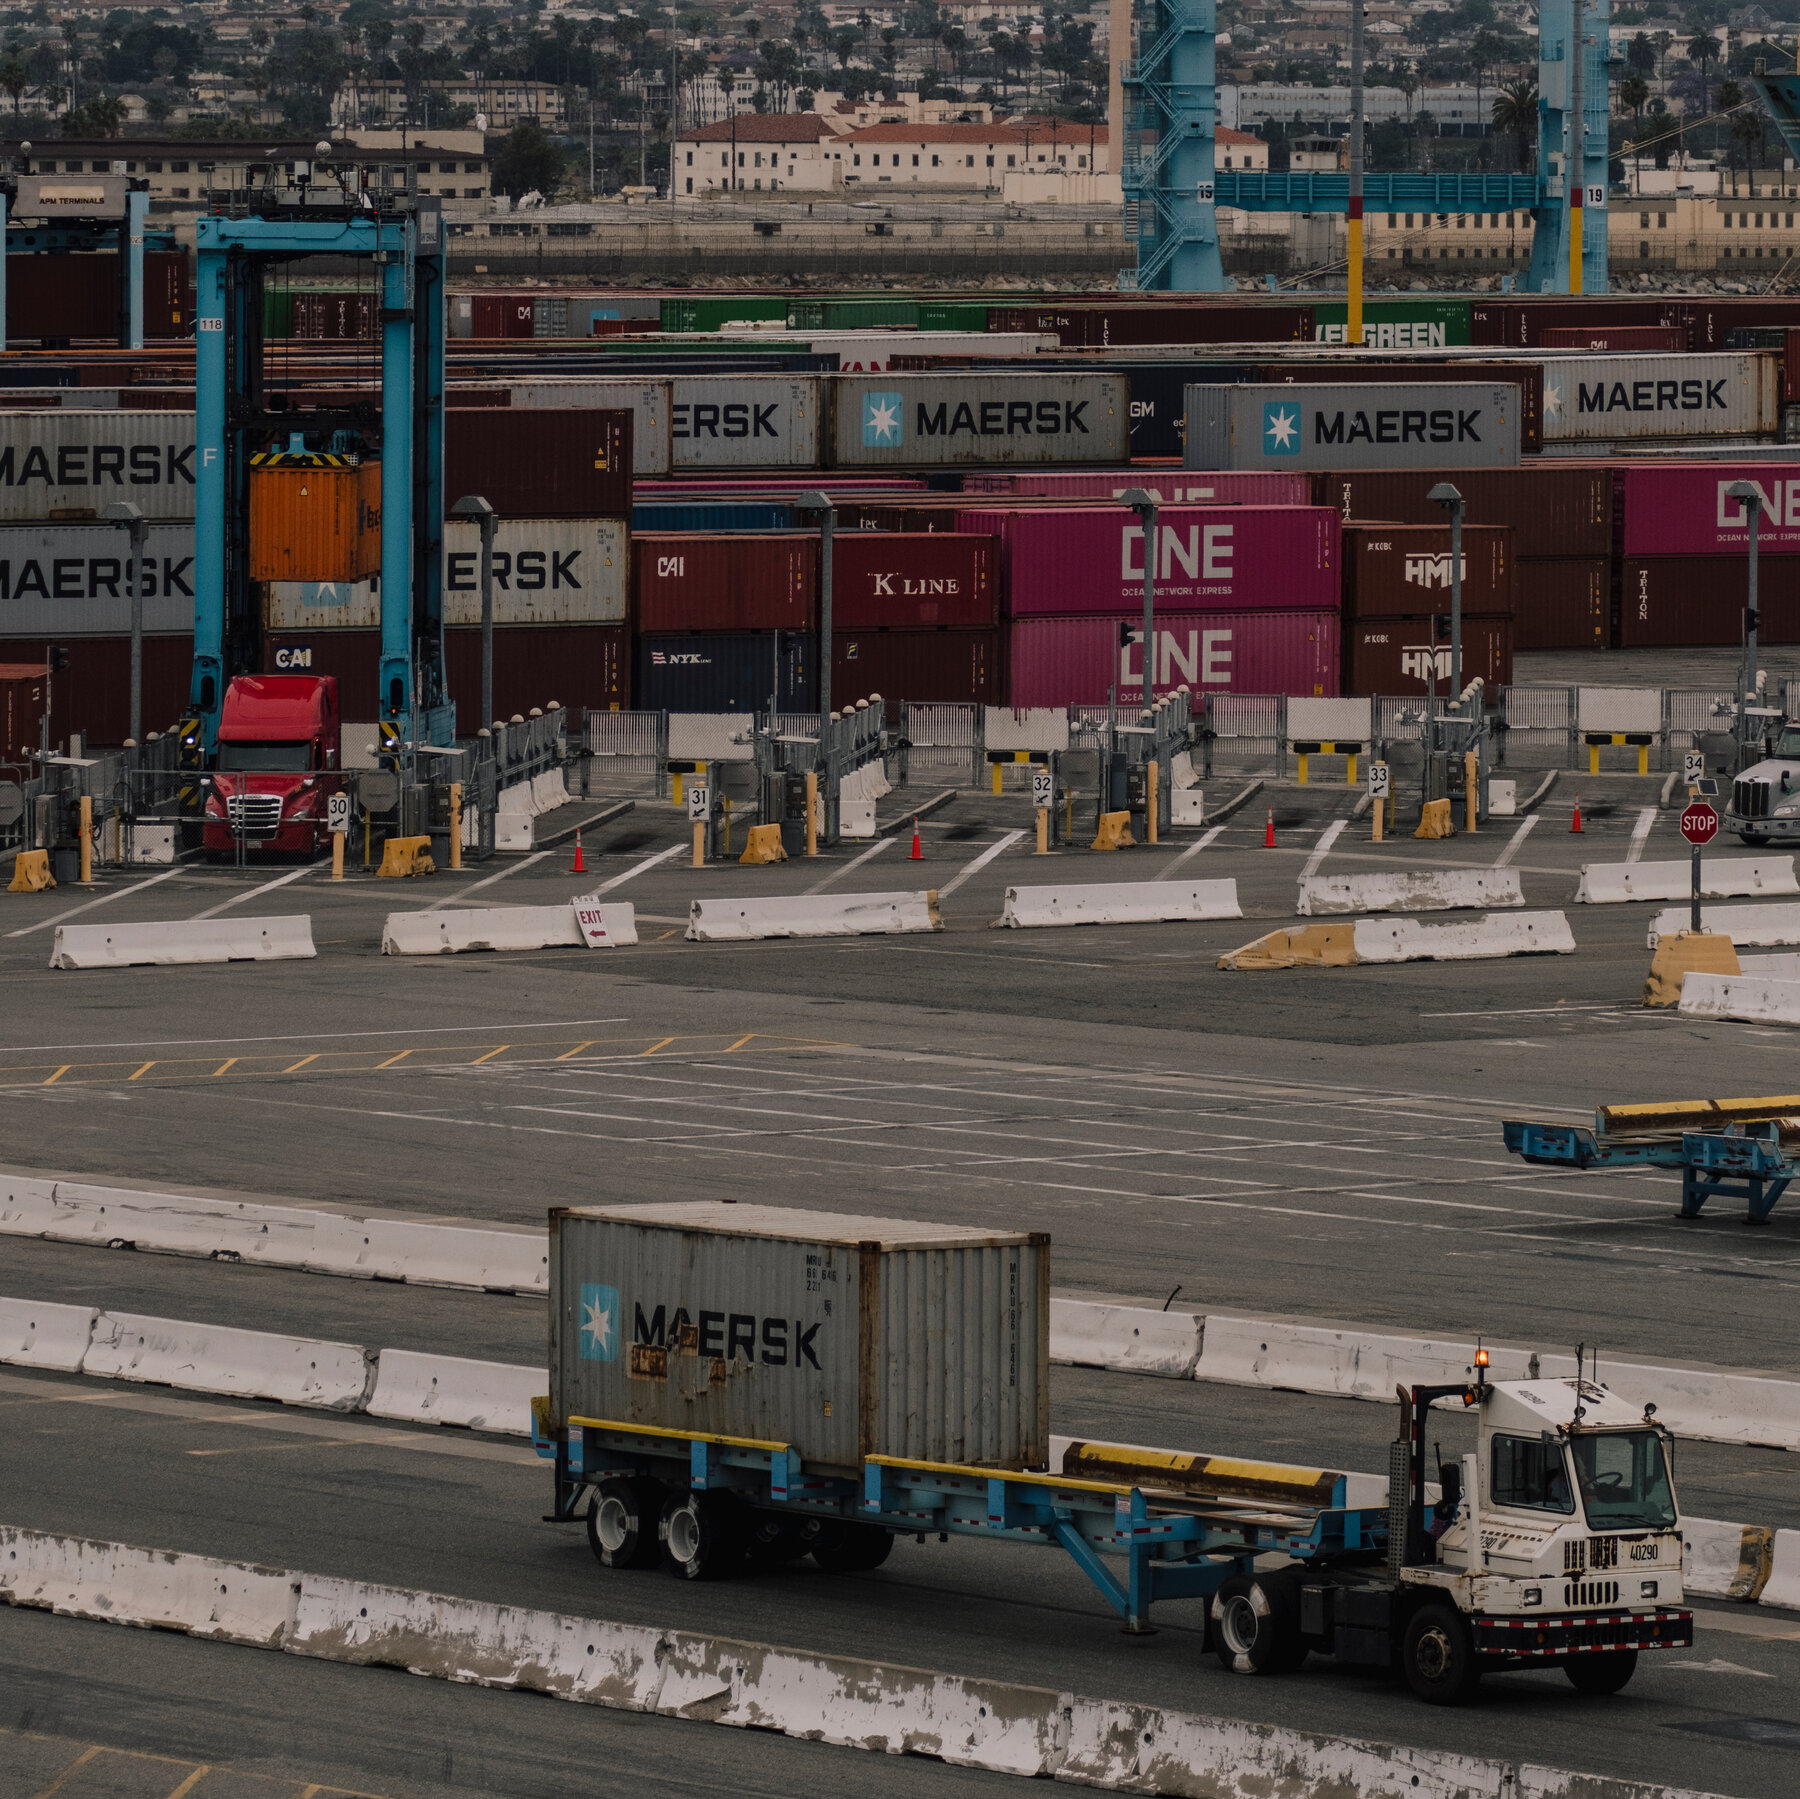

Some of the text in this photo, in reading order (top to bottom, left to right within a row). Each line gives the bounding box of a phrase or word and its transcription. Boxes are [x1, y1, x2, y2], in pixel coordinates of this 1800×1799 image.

[39, 197, 105, 205] APM TERMINALS
[1589, 189, 1602, 202] 19
[518, 306, 531, 320] CA
[202, 319, 223, 331] 118
[1316, 322, 1446, 348] EGREEN
[1579, 379, 1728, 413] MAERSK
[917, 400, 1090, 435] MAERSK
[1130, 401, 1155, 418] GM
[672, 404, 779, 438] ERSK
[1316, 409, 1481, 443] MAERSK
[0, 445, 195, 486] AERSK
[203, 448, 217, 467] F
[1343, 483, 1351, 521] TRIT
[1717, 533, 1741, 542] OCEAN
[1743, 533, 1777, 541] NWORK
[1121, 525, 1234, 580] ONE
[448, 550, 583, 590] ERSK
[658, 557, 684, 577] CAI
[0, 557, 194, 598] AERSK
[903, 579, 960, 594] LINE
[1121, 587, 1144, 597] OCEA
[1196, 585, 1233, 595] EXPRESS
[1639, 570, 1648, 621] TRITON
[276, 647, 312, 669] CAI
[669, 653, 702, 665] NYK
[1120, 629, 1232, 685] ONE
[1120, 692, 1144, 702] OCEA
[1686, 756, 1703, 770] 34
[1370, 767, 1388, 781] 33
[1034, 776, 1051, 791] 32
[692, 790, 706, 804] 31
[330, 799, 347, 814] 30
[1683, 815, 1716, 831] STOP
[579, 909, 603, 924] EXIT
[806, 1254, 822, 1267] MRU
[634, 1302, 823, 1370] MAERSK
[1630, 1544, 1658, 1561] 40290
